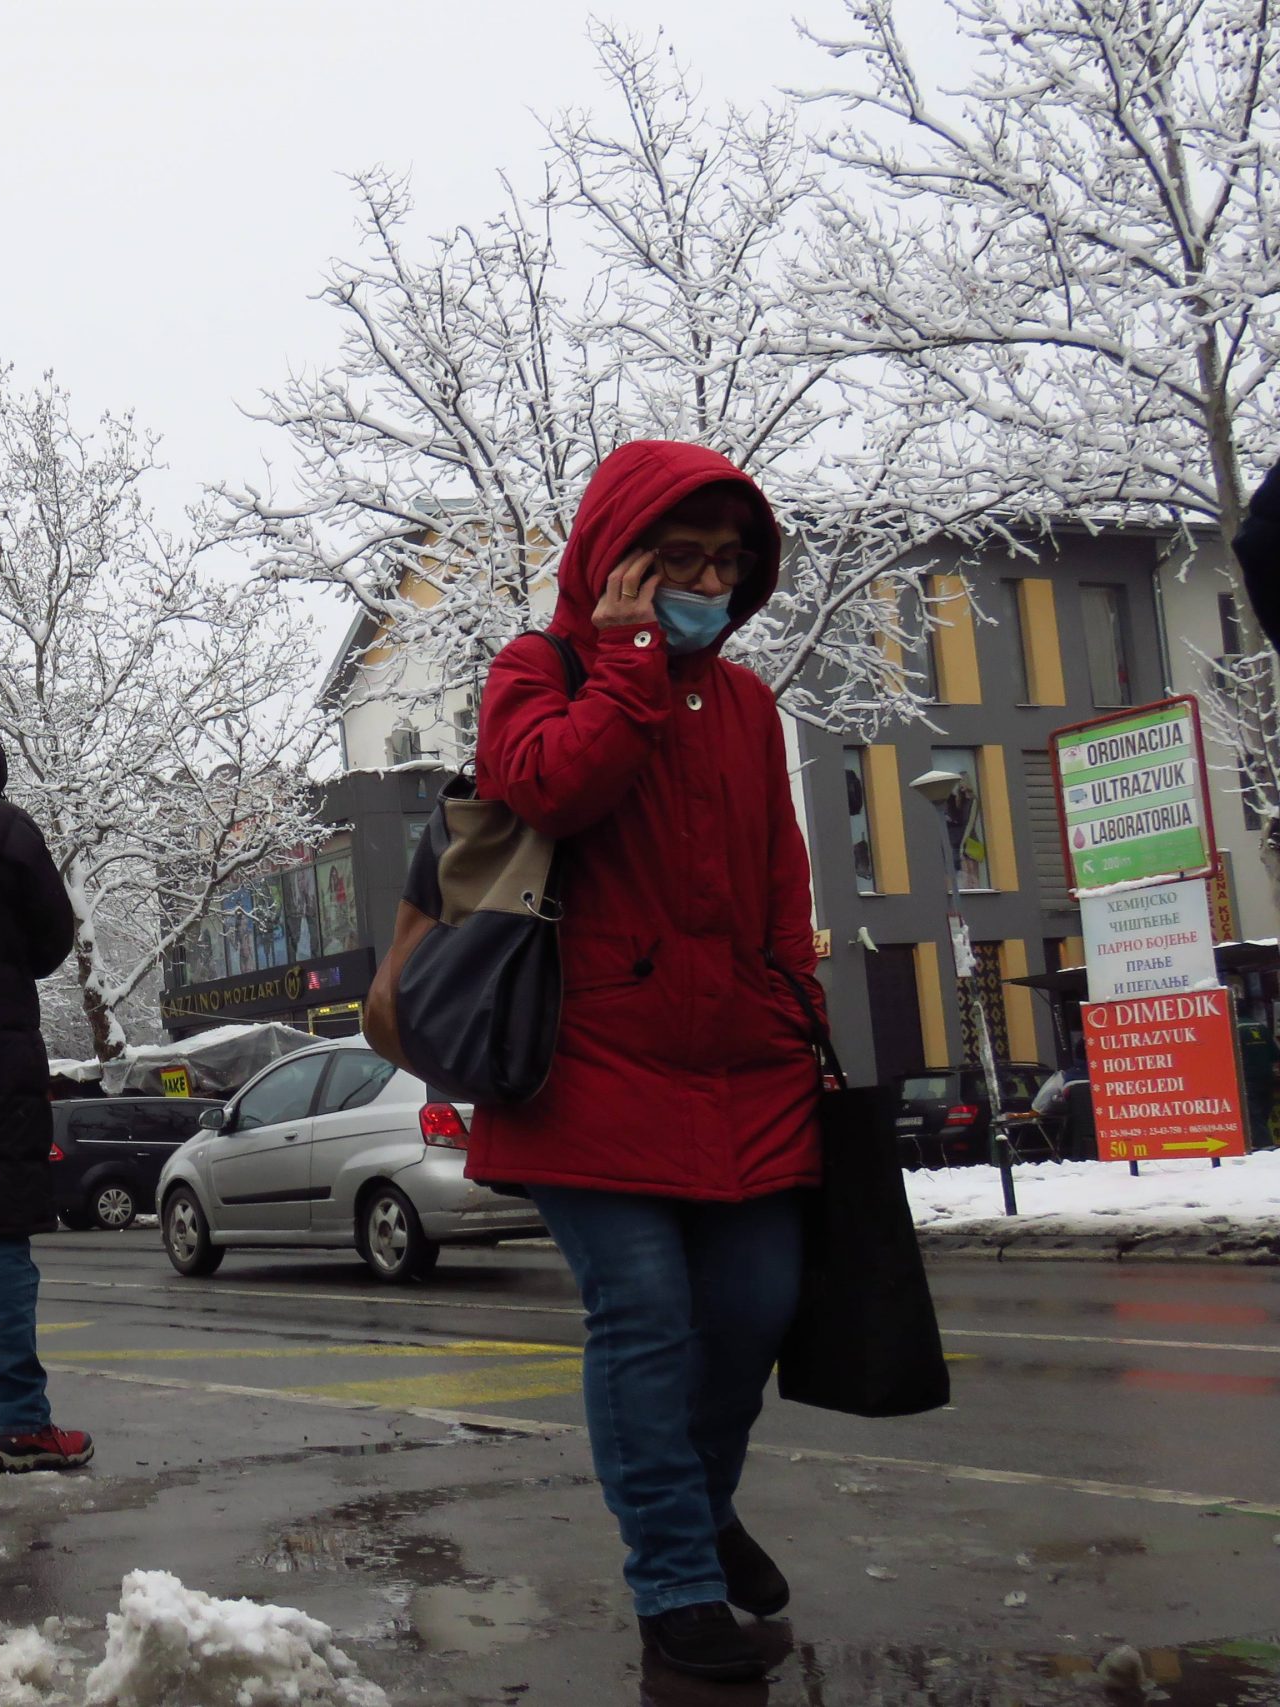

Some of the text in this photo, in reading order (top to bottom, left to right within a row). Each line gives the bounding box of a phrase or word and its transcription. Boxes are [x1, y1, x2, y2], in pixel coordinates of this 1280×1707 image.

[1087, 723, 1183, 766] ORDINACIJA
[1091, 762, 1186, 805] ULTRAZVUK
[1090, 803, 1192, 845] LABORATORIJA
[1107, 891, 1178, 913] ХЕМИЈСКО
[1109, 912, 1180, 934] ЧИШЋЕЊЕ
[1096, 931, 1199, 956] ПАРНО БОЈЕЊЕ
[1126, 956, 1174, 973] ПРАЊЕ
[224, 979, 281, 1005] MOZZART
[1114, 975, 1190, 995] И ПЕГЛАЊЕ
[1114, 994, 1221, 1026] DIMEDIK
[1099, 1027, 1197, 1050] ULTRAZVUK
[1103, 1053, 1173, 1073] HOLTERI
[1105, 1077, 1184, 1097] PREGLEDI
[1108, 1098, 1232, 1120] LABORATORIJA
[1110, 1140, 1148, 1158] 50 m
